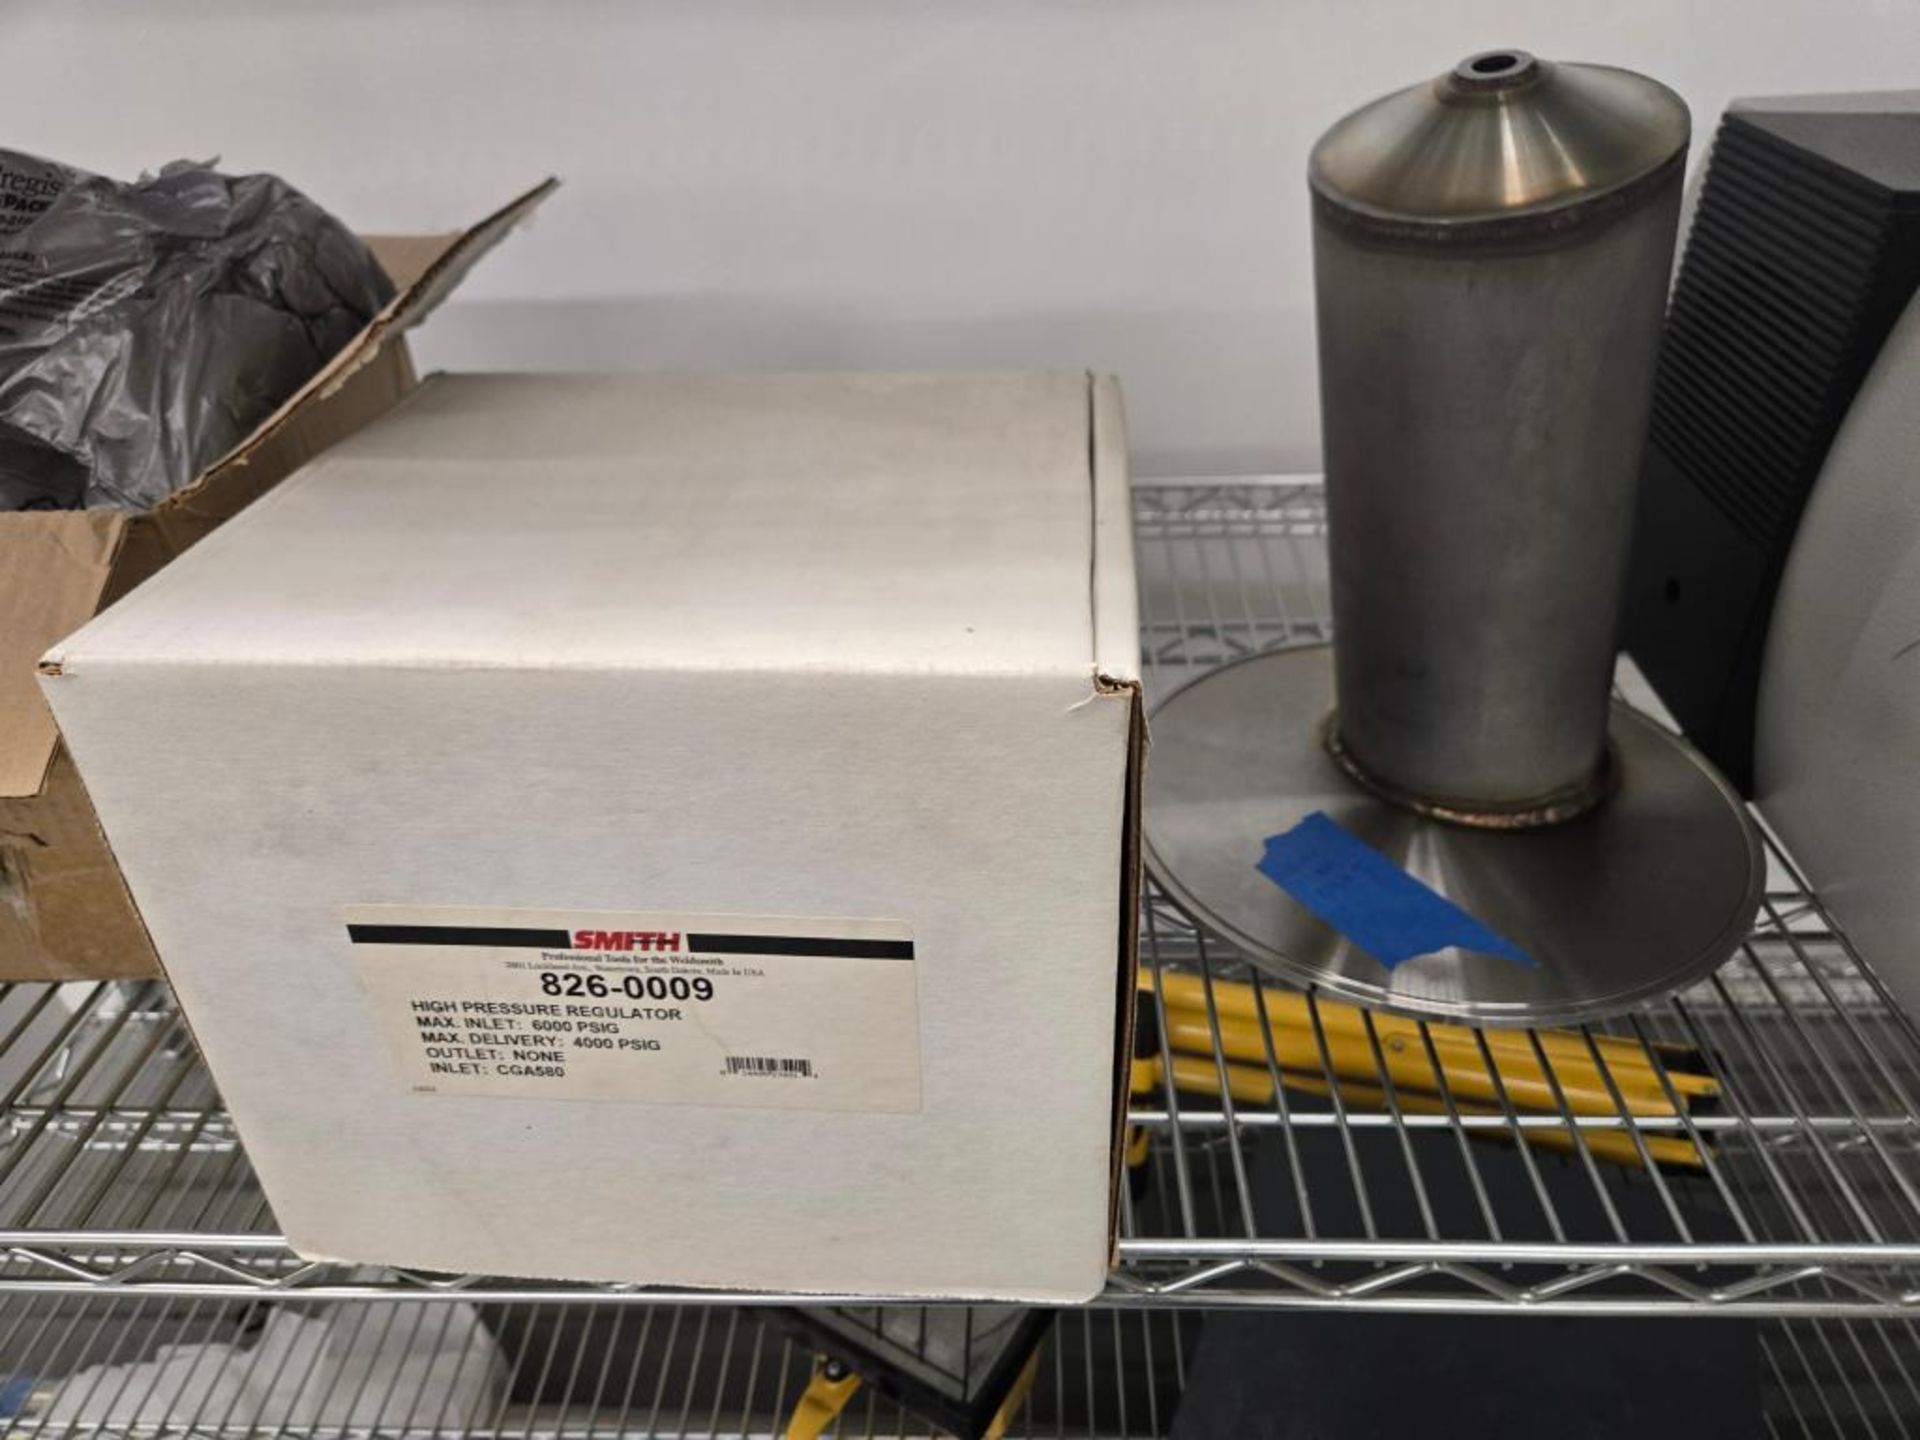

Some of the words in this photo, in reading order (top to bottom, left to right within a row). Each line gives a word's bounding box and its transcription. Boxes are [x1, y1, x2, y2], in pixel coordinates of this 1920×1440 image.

[574, 929, 680, 951] SMITH
[633, 955, 648, 964] for
[651, 956, 667, 965] the
[541, 971, 714, 1002] 826-0009
[411, 1000, 458, 1013] HIGH
[462, 1001, 561, 1017] PRESSURE
[565, 1004, 682, 1021] REGULATOR
[416, 1015, 461, 1029] MAX.
[464, 1017, 523, 1031] INLET:
[532, 1019, 573, 1032] 6000
[577, 1021, 620, 1034] PSIG
[421, 1031, 465, 1044] MAX.
[469, 1032, 564, 1048] DELIVERY:
[573, 1036, 613, 1049] 4000
[618, 1038, 661, 1051] PSIG
[425, 1047, 505, 1061] OUTLET:
[513, 1050, 565, 1062] NONE
[429, 1062, 489, 1075] INLET:
[496, 1064, 565, 1078] CGA580
